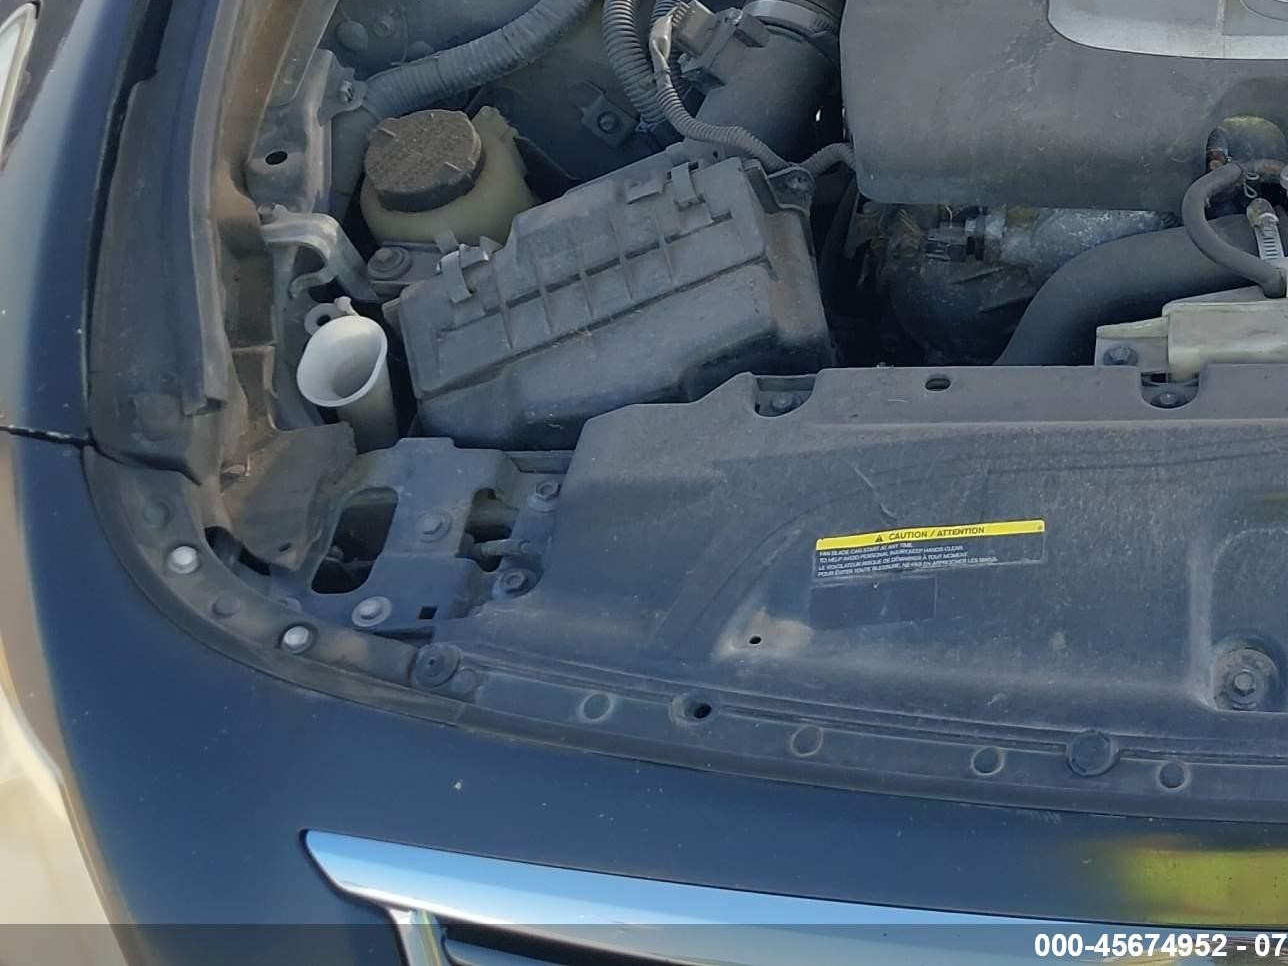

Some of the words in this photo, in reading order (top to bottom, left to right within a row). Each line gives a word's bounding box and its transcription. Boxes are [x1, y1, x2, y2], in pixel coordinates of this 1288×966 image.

[888, 530, 928, 540] CAUTION
[930, 529, 935, 538] /
[937, 527, 985, 537] ATTENTION
